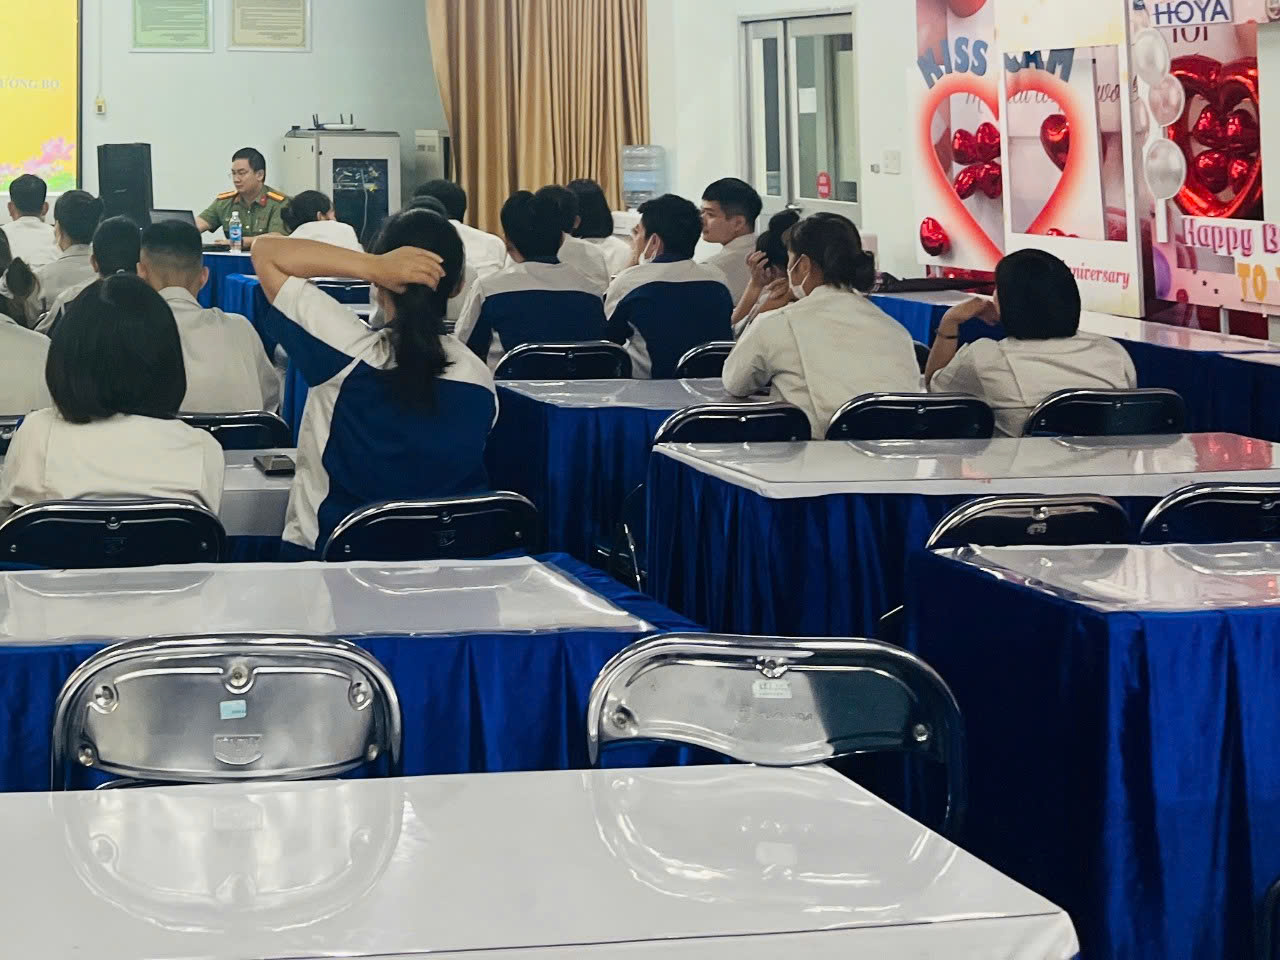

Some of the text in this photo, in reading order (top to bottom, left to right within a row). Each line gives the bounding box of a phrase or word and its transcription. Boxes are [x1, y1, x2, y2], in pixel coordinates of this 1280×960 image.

[917, 37, 989, 90] KISS
[1183, 218, 1252, 257] Happy
[1070, 262, 1130, 290] niversary
